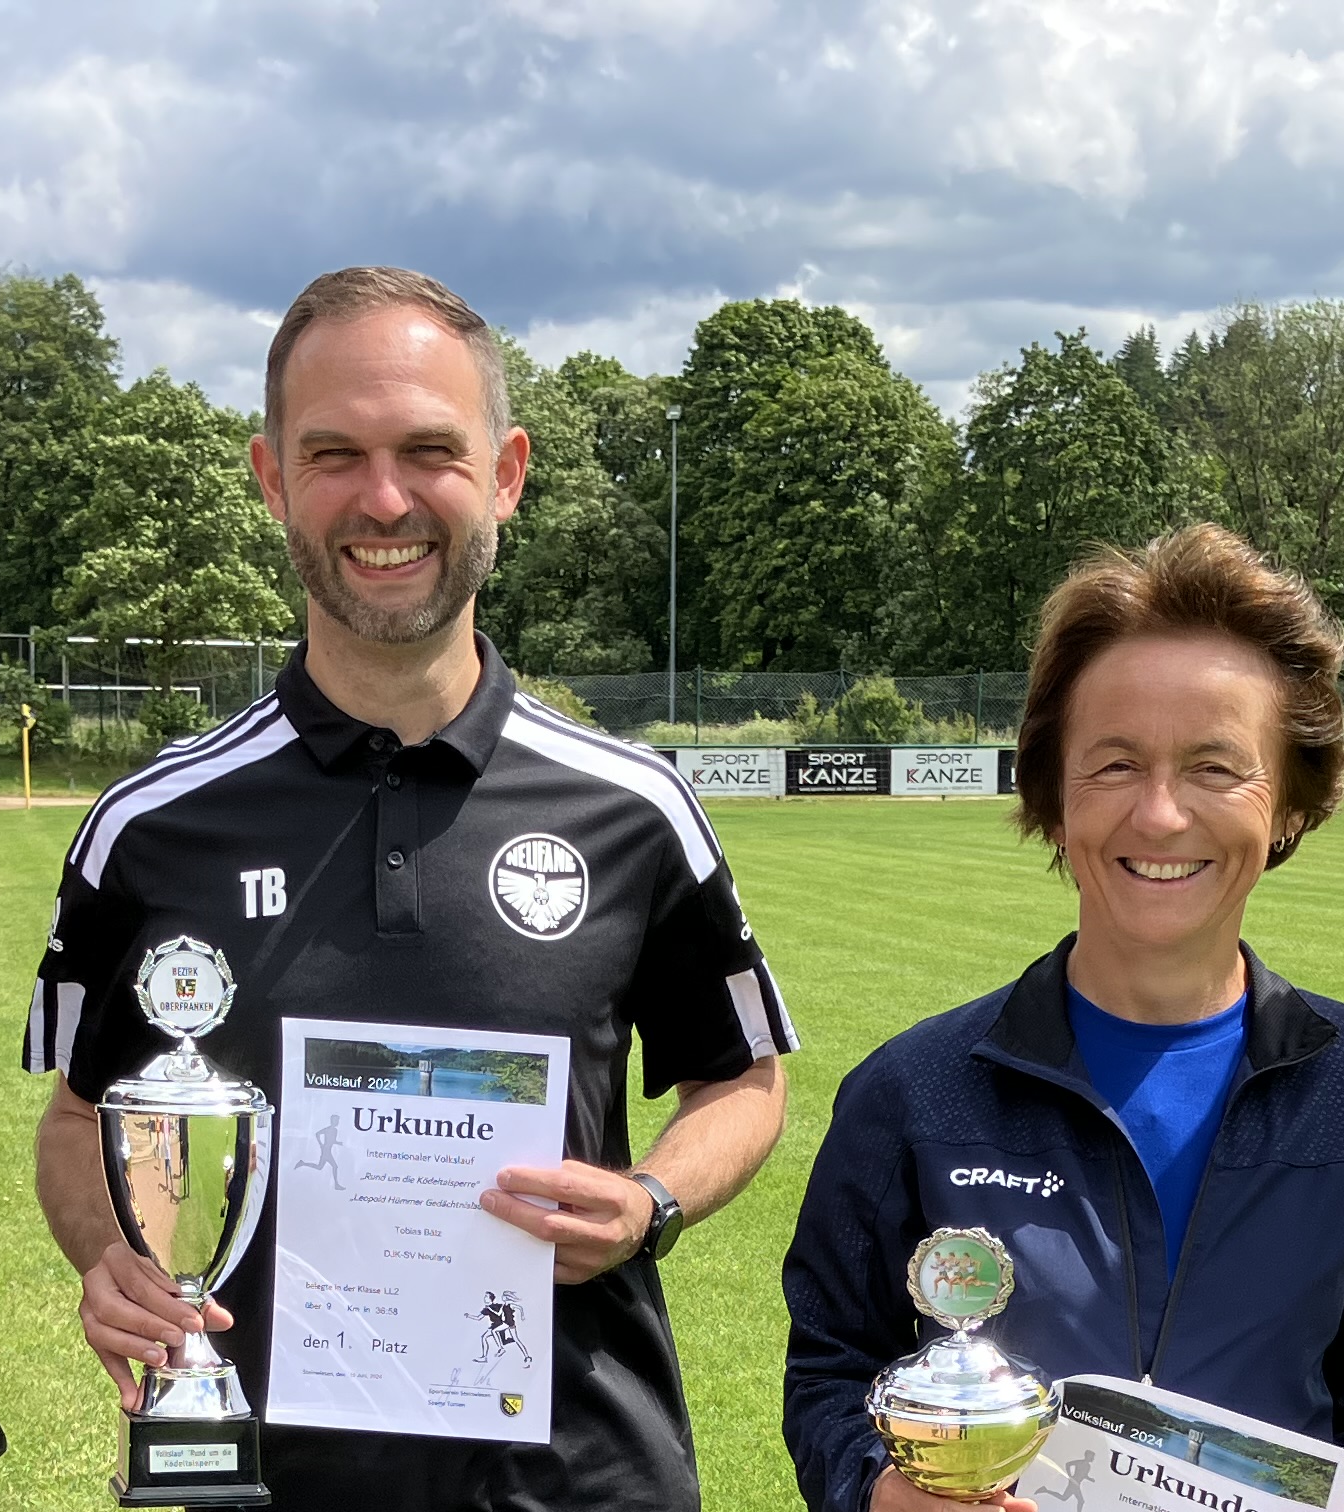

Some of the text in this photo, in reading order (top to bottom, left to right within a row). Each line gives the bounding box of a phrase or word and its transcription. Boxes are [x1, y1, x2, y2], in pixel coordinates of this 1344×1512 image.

[701, 754, 760, 765] SPORT
[808, 753, 867, 765] SPORT
[916, 753, 973, 764] SPORT
[692, 769, 771, 784] KANZE
[798, 768, 877, 784] KANZE
[906, 768, 983, 783] KANZE
[506, 840, 576, 872] NEUFANG
[240, 867, 287, 919] TB
[172, 967, 198, 977] BEZIRK
[159, 1002, 214, 1012] OBERFRANKEN
[306, 1072, 398, 1091] Volkslauf 2024
[352, 1106, 494, 1141] Urkunde
[366, 1149, 476, 1165] Internationaler Volkslauf
[387, 1175, 401, 1183] um
[402, 1175, 415, 1184] die
[949, 1167, 1041, 1194] CRAFT
[395, 1225, 422, 1236] Tobias
[417, 1252, 452, 1264] Neufang
[357, 1285, 381, 1294] Klasse
[303, 1331, 408, 1354] den 1. Platz
[1064, 1404, 1164, 1448] Volkslauf 2024
